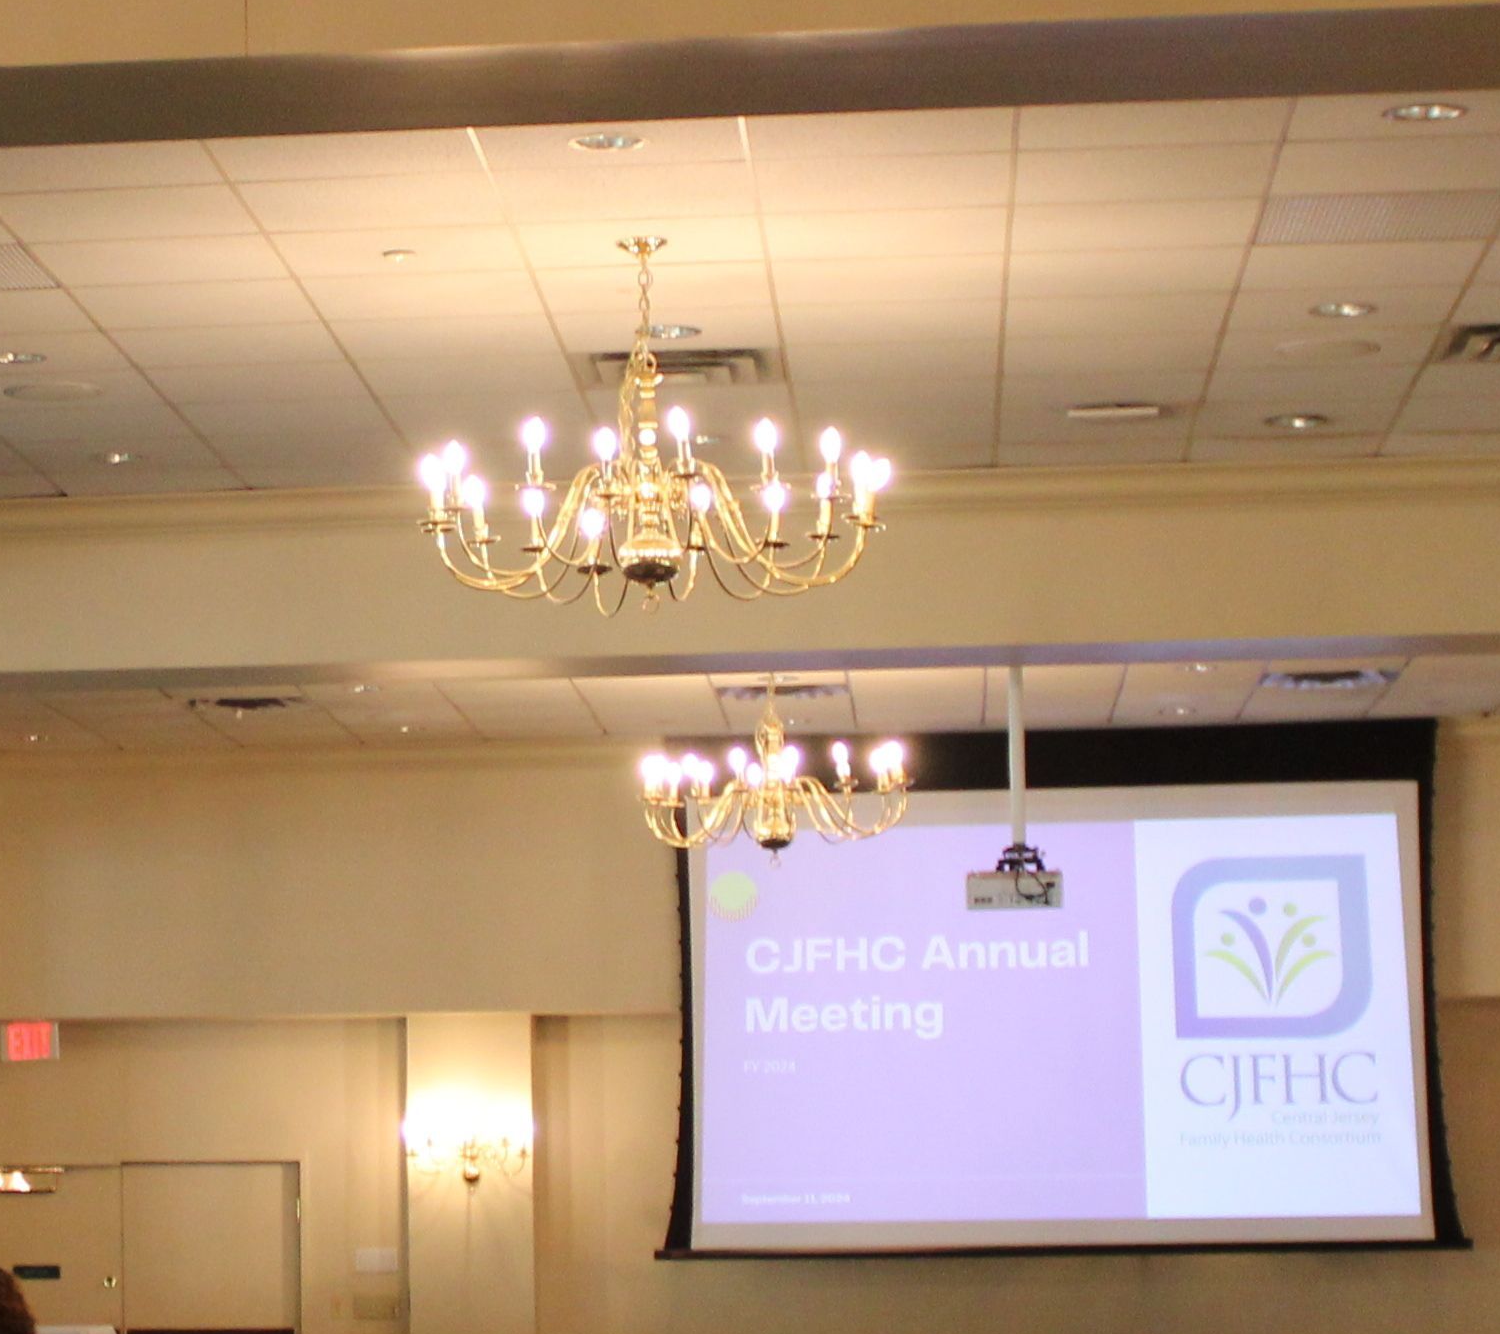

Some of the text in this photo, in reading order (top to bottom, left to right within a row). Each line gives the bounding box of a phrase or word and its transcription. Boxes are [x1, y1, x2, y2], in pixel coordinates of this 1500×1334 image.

[746, 931, 1089, 973] CJFHC Annual
[745, 997, 944, 1039] Meeting
[9, 1025, 50, 1059] EXIT
[1181, 1052, 1378, 1120] CJFHC
[1271, 1110, 1380, 1128] Central Jersey
[1179, 1130, 1382, 1150] Family Health Consortium
